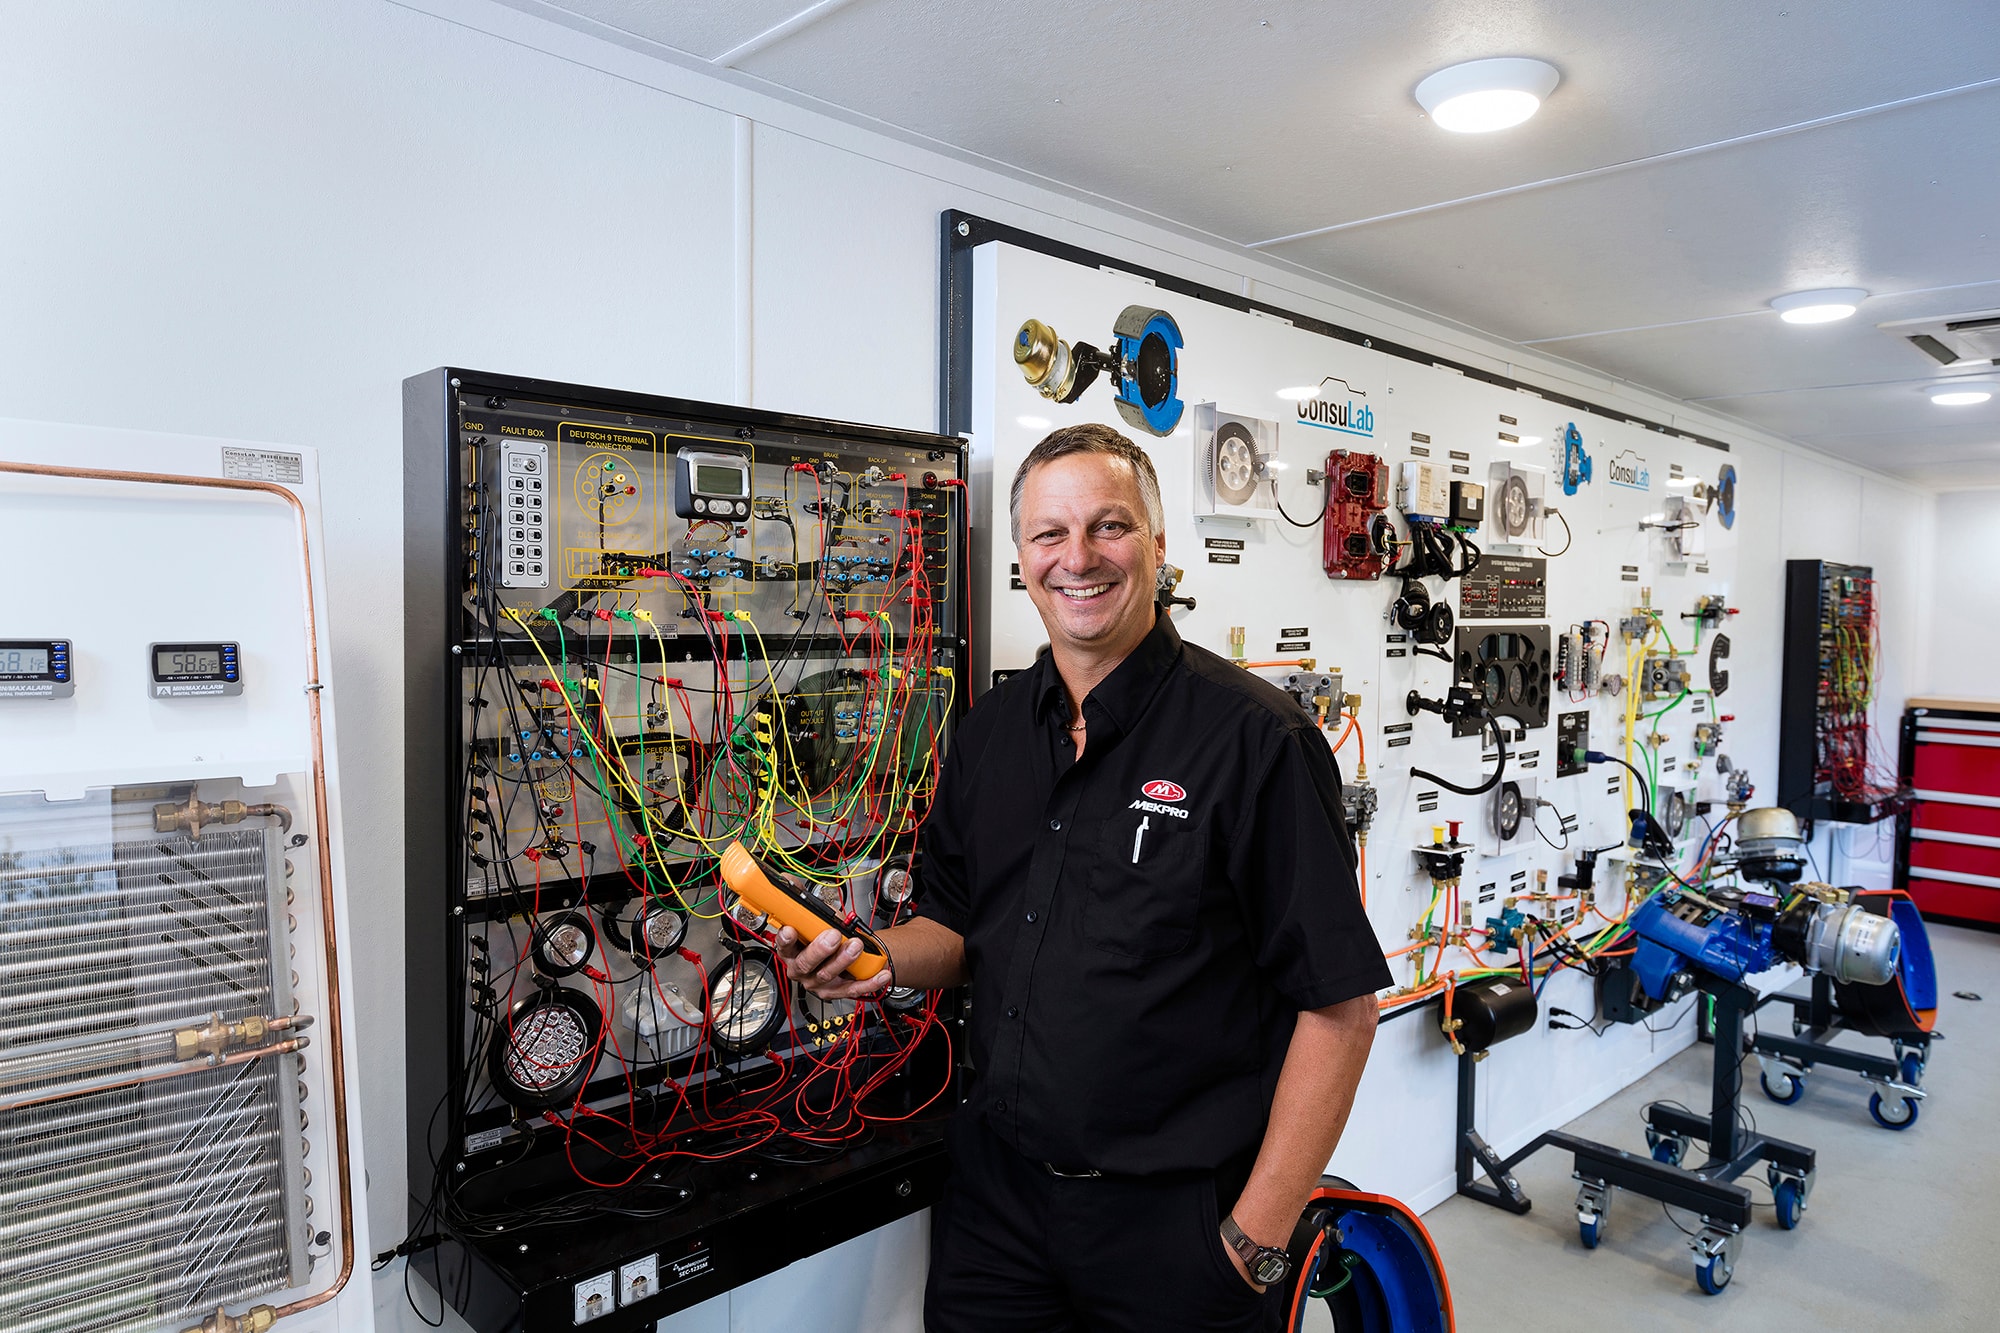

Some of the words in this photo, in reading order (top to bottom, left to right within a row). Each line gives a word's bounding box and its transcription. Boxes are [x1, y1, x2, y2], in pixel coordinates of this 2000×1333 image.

[1297, 399, 1374, 432] ConsuLab
[464, 421, 484, 431] GND
[501, 425, 526, 436] FAULT
[527, 428, 545, 437] BOX
[569, 429, 605, 441] DEUTSCH
[606, 433, 612, 441] 9
[613, 434, 649, 446] TERMINAL
[585, 440, 633, 452] CONNECTOR
[823, 451, 839, 459] BRAKE
[867, 456, 888, 464] BACK-UP
[1609, 460, 1650, 487] ConsuLab
[914, 626, 942, 635] ConsLab
[635, 745, 687, 755] ACELERAOR
[1128, 799, 1189, 819] MEKPRO
